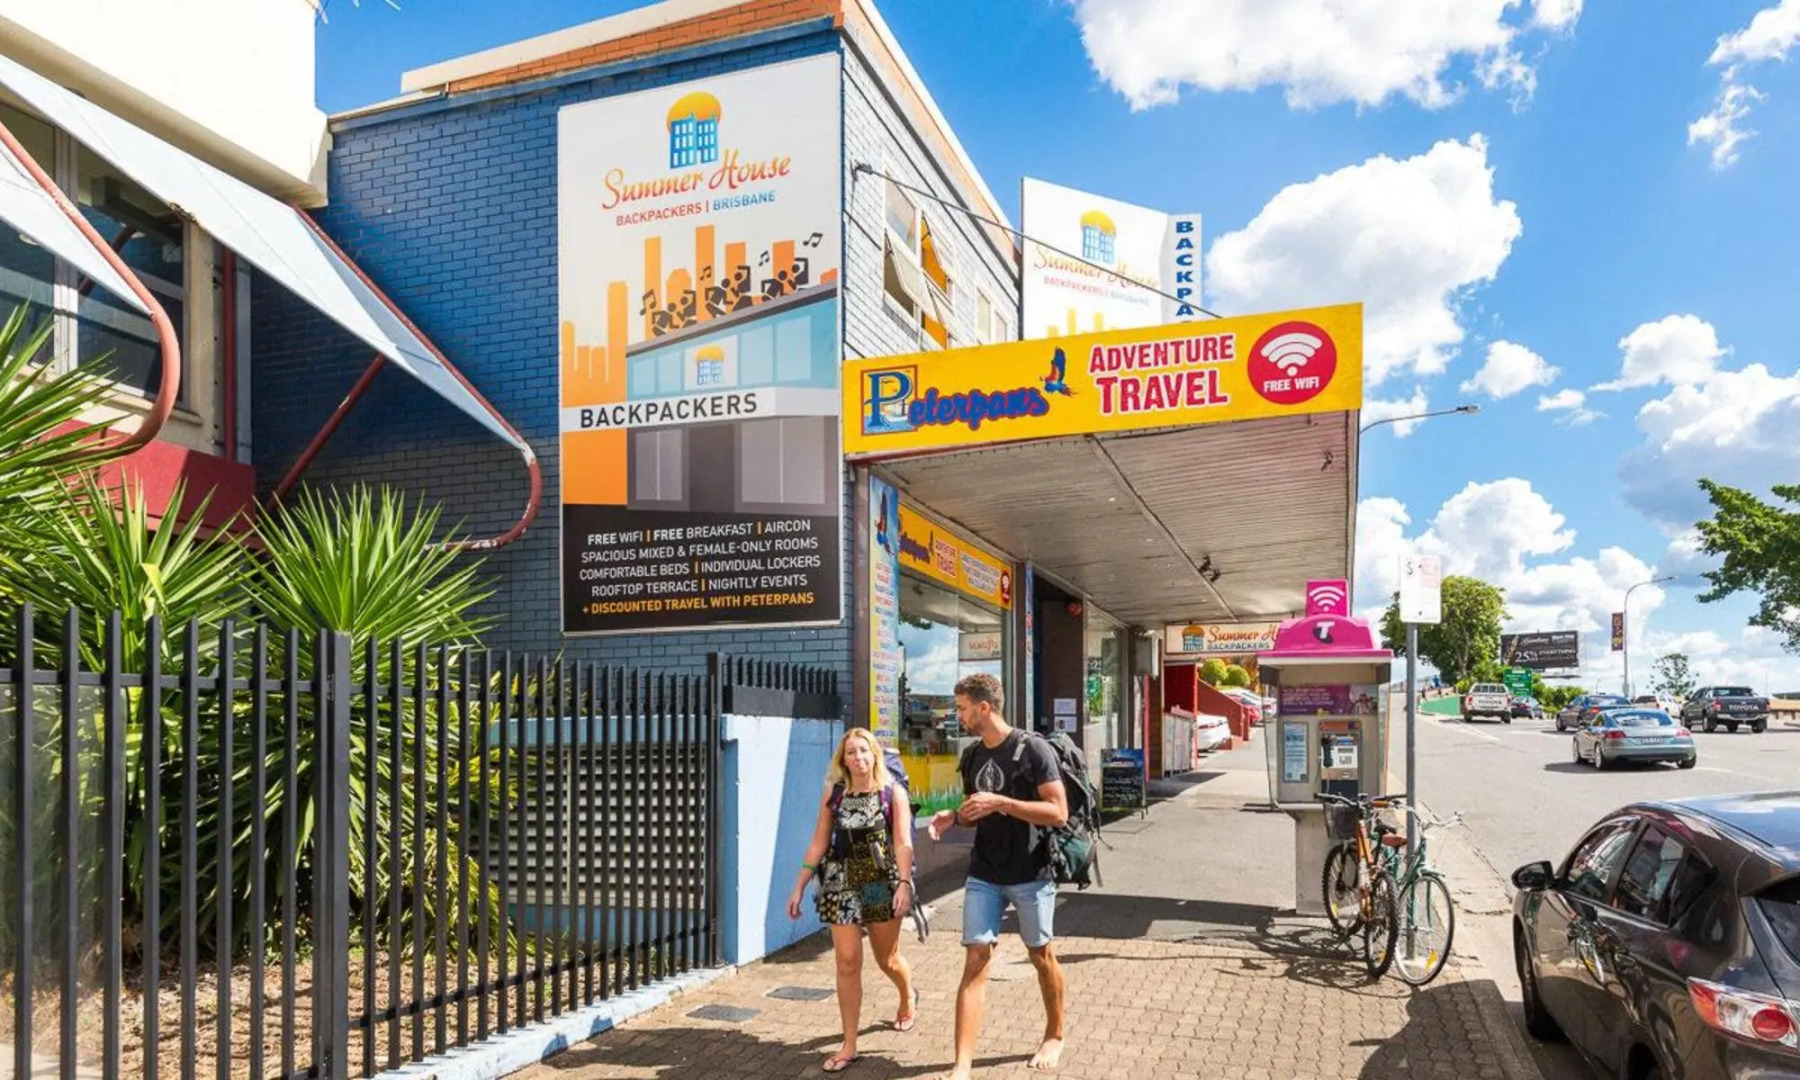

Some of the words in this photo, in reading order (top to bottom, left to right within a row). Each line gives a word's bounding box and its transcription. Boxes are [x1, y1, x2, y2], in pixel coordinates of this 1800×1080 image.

[602, 168, 704, 209] Summer
[708, 149, 791, 190] House
[615, 203, 702, 226] BACKPACKERS
[713, 189, 776, 211] BRISBANE
[1175, 221, 1195, 323] BACKPA
[1089, 334, 1234, 373] ADVENTURE
[1096, 369, 1228, 413] TRAVEL
[1263, 379, 1291, 393] FREE
[1294, 375, 1320, 390] WIFI
[580, 392, 758, 429] BACKPACKERS
[865, 371, 1050, 431] Peterpans
[587, 532, 617, 546] FREE
[618, 530, 643, 543] WIFI
[653, 528, 684, 541] FREE
[686, 522, 753, 539] BREAKFAST
[764, 519, 811, 534] AIRCON
[581, 548, 637, 564] SPACIOUS
[638, 546, 674, 559] MIXED
[677, 545, 686, 557] &
[689, 539, 771, 556] FEMALE-ONLY
[774, 536, 818, 551] ROOMS
[579, 564, 658, 581] COMFORTABLE
[659, 562, 690, 576] BEDS
[701, 557, 765, 573] INDIVIDUAL
[766, 554, 821, 570] LOCKERS
[591, 582, 643, 597] ROOFTOP
[645, 579, 698, 595] TERRACE
[708, 576, 758, 591] NIGHTLY
[760, 573, 807, 588] EVENTS
[591, 600, 662, 615] DISCOUNTED
[664, 596, 708, 611] TRAVEL
[710, 594, 741, 608] WITH
[743, 591, 814, 607] PETERPANS
[1207, 640, 1271, 651] BACKPACKERS
[1208, 624, 1259, 643] Summer
